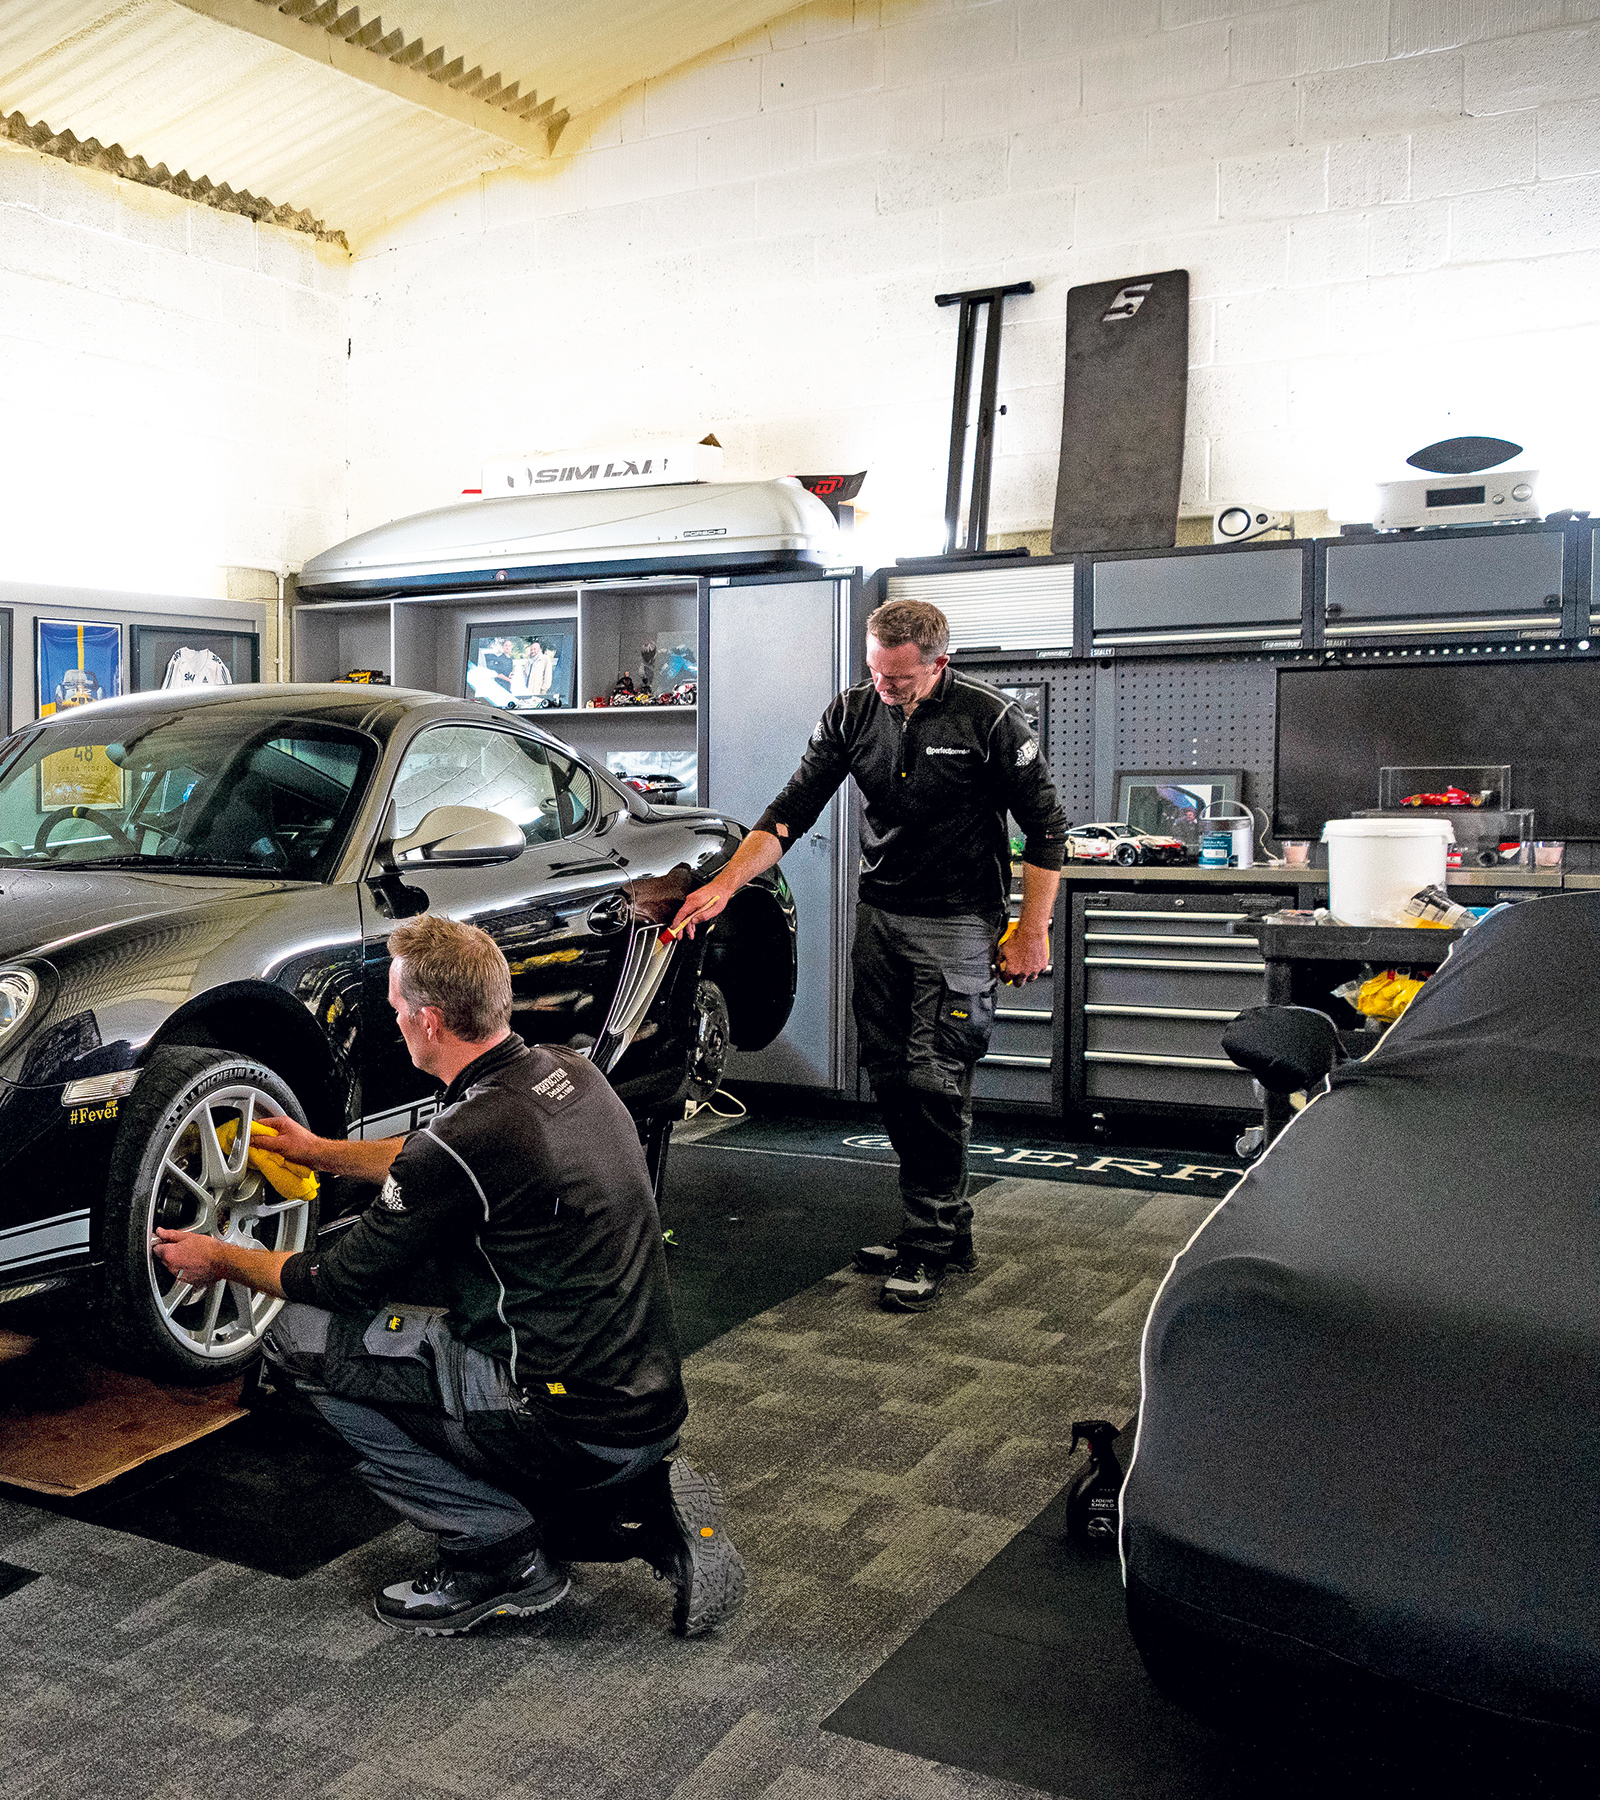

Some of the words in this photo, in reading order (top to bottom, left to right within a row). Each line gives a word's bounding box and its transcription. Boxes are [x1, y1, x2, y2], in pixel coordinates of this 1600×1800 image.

[535, 464, 600, 484] SIM
[184, 672, 196, 683] sky
[198, 1067, 247, 1095] MICHELIN
[531, 1068, 568, 1096] PERFECTION
[546, 1079, 571, 1099] Detailers
[69, 1106, 118, 1125] #Fever
